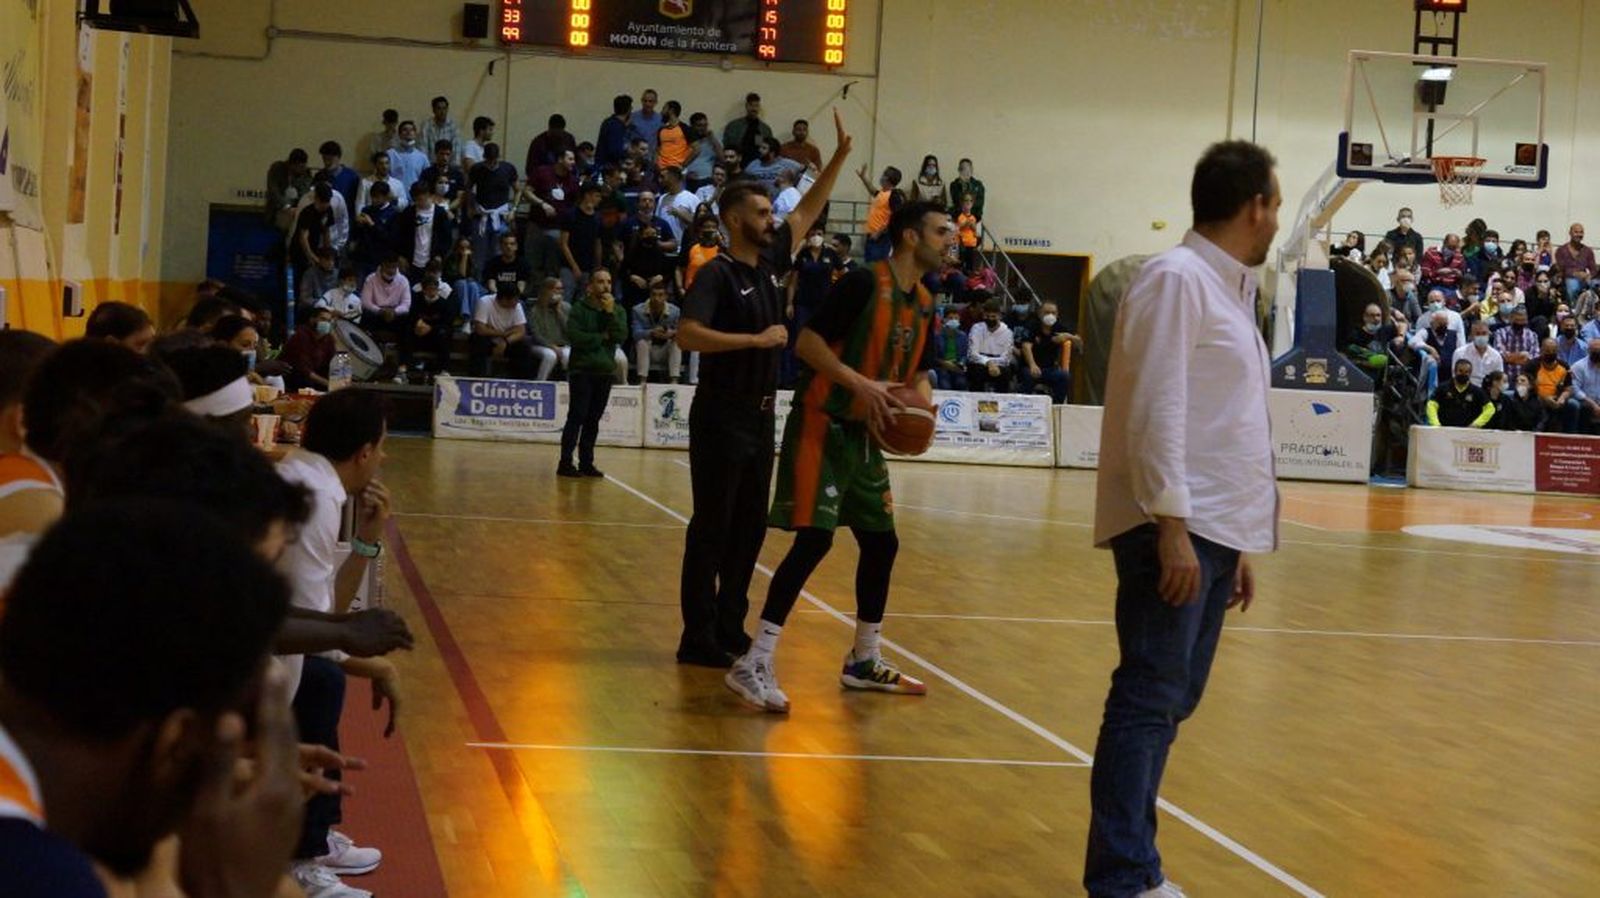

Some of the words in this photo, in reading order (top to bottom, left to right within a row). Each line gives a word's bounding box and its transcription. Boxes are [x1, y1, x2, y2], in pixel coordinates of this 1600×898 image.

[503, 9, 521, 23] 33
[570, 13, 590, 28] 00
[826, 14, 845, 28] 00
[502, 26, 520, 40] 99
[627, 21, 705, 36] Ayuntamiento
[707, 27, 722, 37] de
[760, 27, 777, 40] 77
[569, 30, 589, 46] 00
[610, 33, 657, 46] MORÓN
[660, 38, 674, 47] de
[677, 38, 688, 48] la
[691, 39, 738, 52] Frontera
[825, 32, 844, 46] 00
[758, 44, 776, 58] 99
[824, 49, 843, 64] 00
[471, 382, 543, 401] Clínica
[470, 399, 543, 418] Dental
